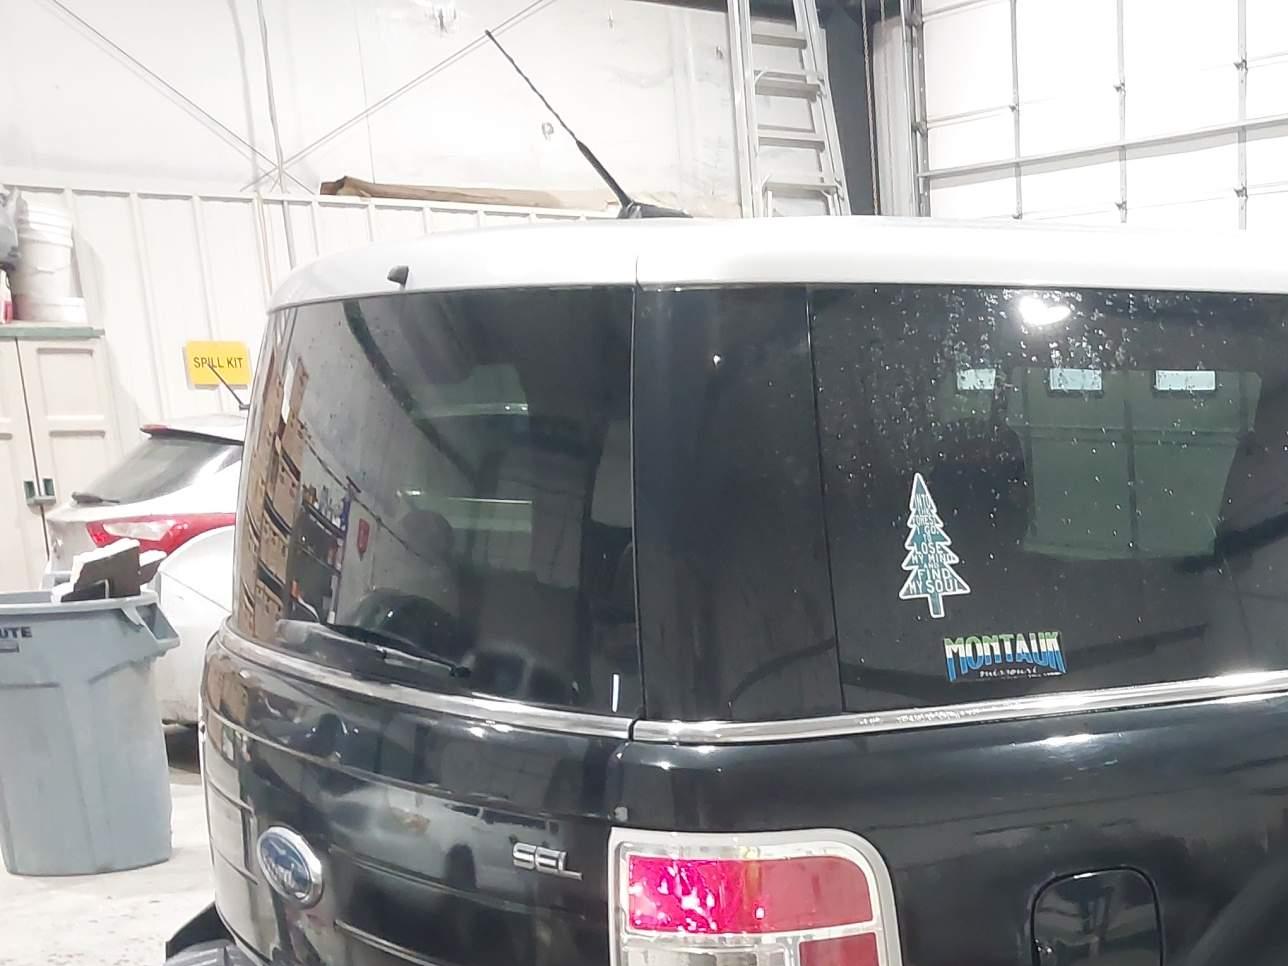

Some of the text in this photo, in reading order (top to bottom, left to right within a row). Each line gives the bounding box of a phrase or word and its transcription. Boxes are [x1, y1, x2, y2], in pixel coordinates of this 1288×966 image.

[193, 356, 243, 369] SPILL KIT
[914, 542, 944, 555] LOSE
[911, 553, 953, 564] MY MIND
[917, 567, 951, 581] FIND
[909, 579, 963, 594] MY SOUL
[943, 631, 1066, 683] MONTAUK
[512, 842, 583, 880] SEL
